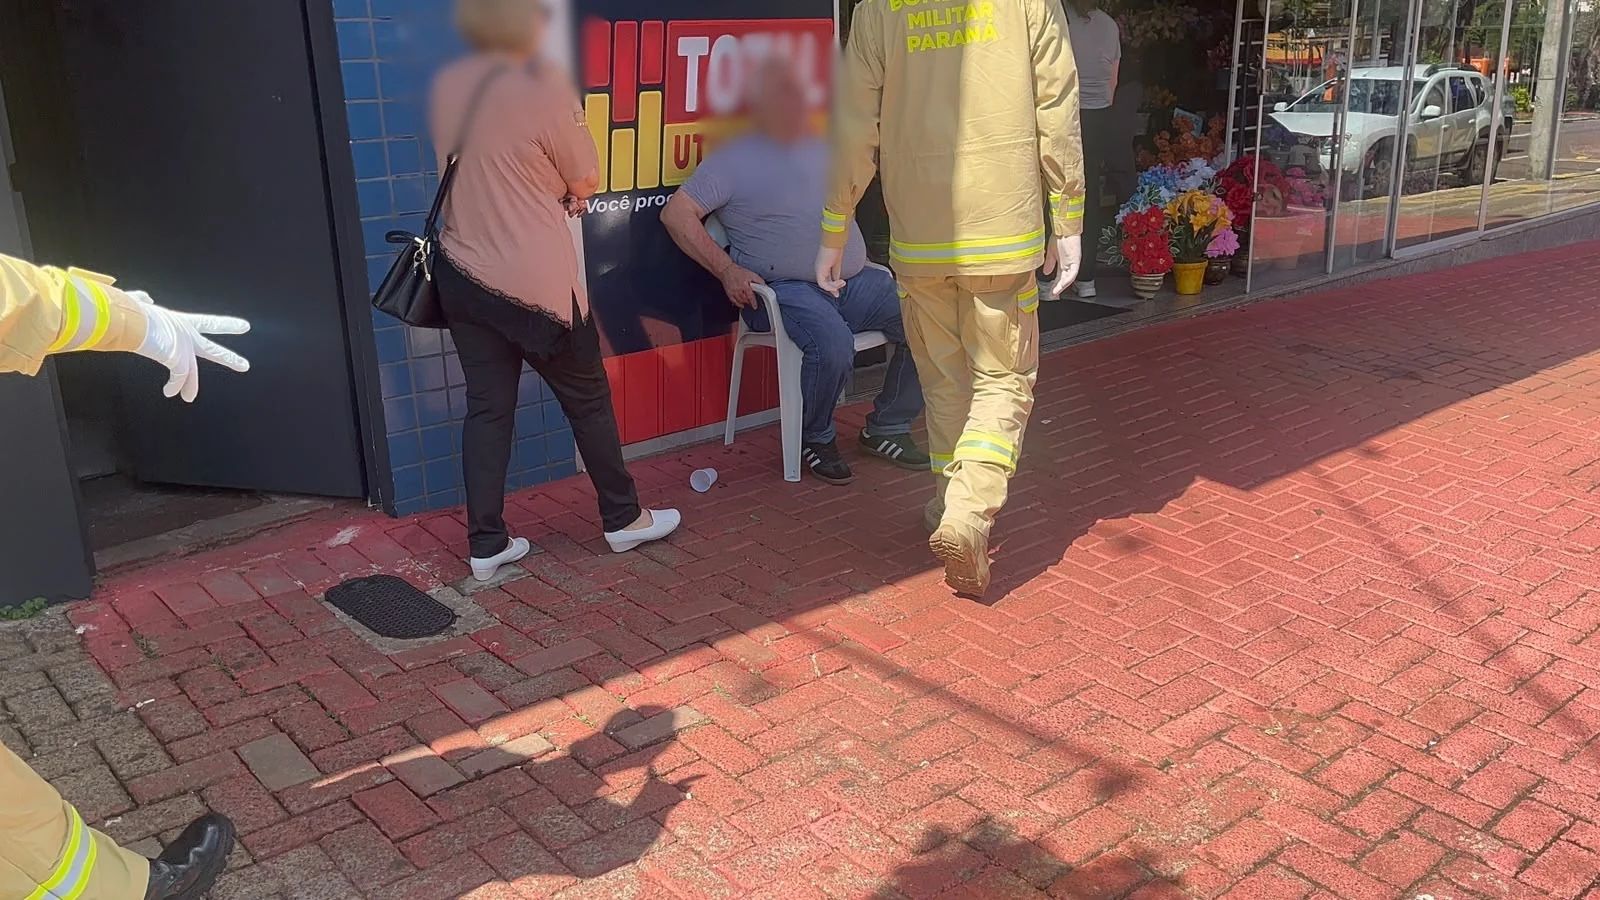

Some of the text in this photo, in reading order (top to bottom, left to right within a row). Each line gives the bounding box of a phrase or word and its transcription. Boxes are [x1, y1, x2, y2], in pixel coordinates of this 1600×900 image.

[907, 2, 994, 30] MILITAR
[906, 18, 998, 53] PARANÁ
[585, 194, 631, 214] Você
